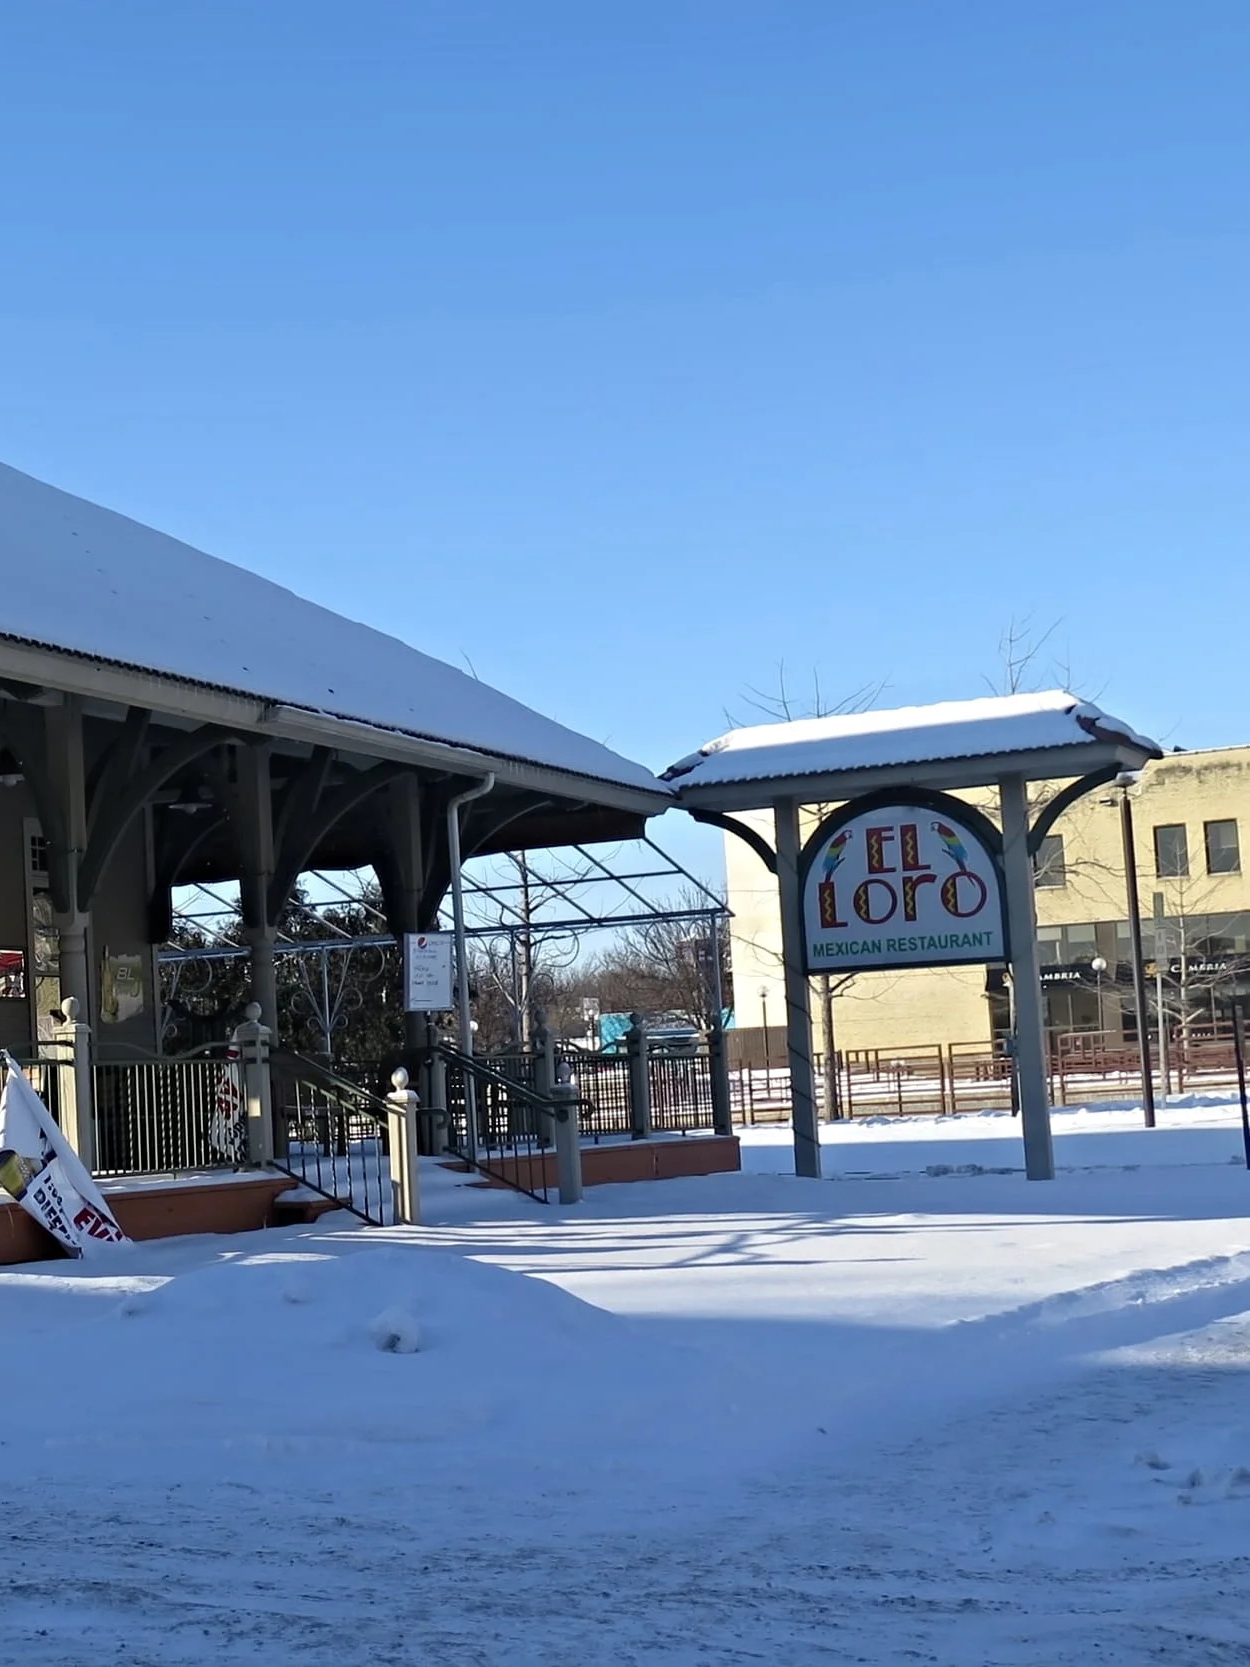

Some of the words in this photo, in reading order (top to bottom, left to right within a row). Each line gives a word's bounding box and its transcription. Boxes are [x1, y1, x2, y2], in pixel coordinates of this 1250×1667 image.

[866, 823, 931, 875] EL
[812, 939, 882, 958] MEXICAN
[886, 931, 994, 954] RESTAURANT
[1170, 962, 1227, 973] CMBRIA
